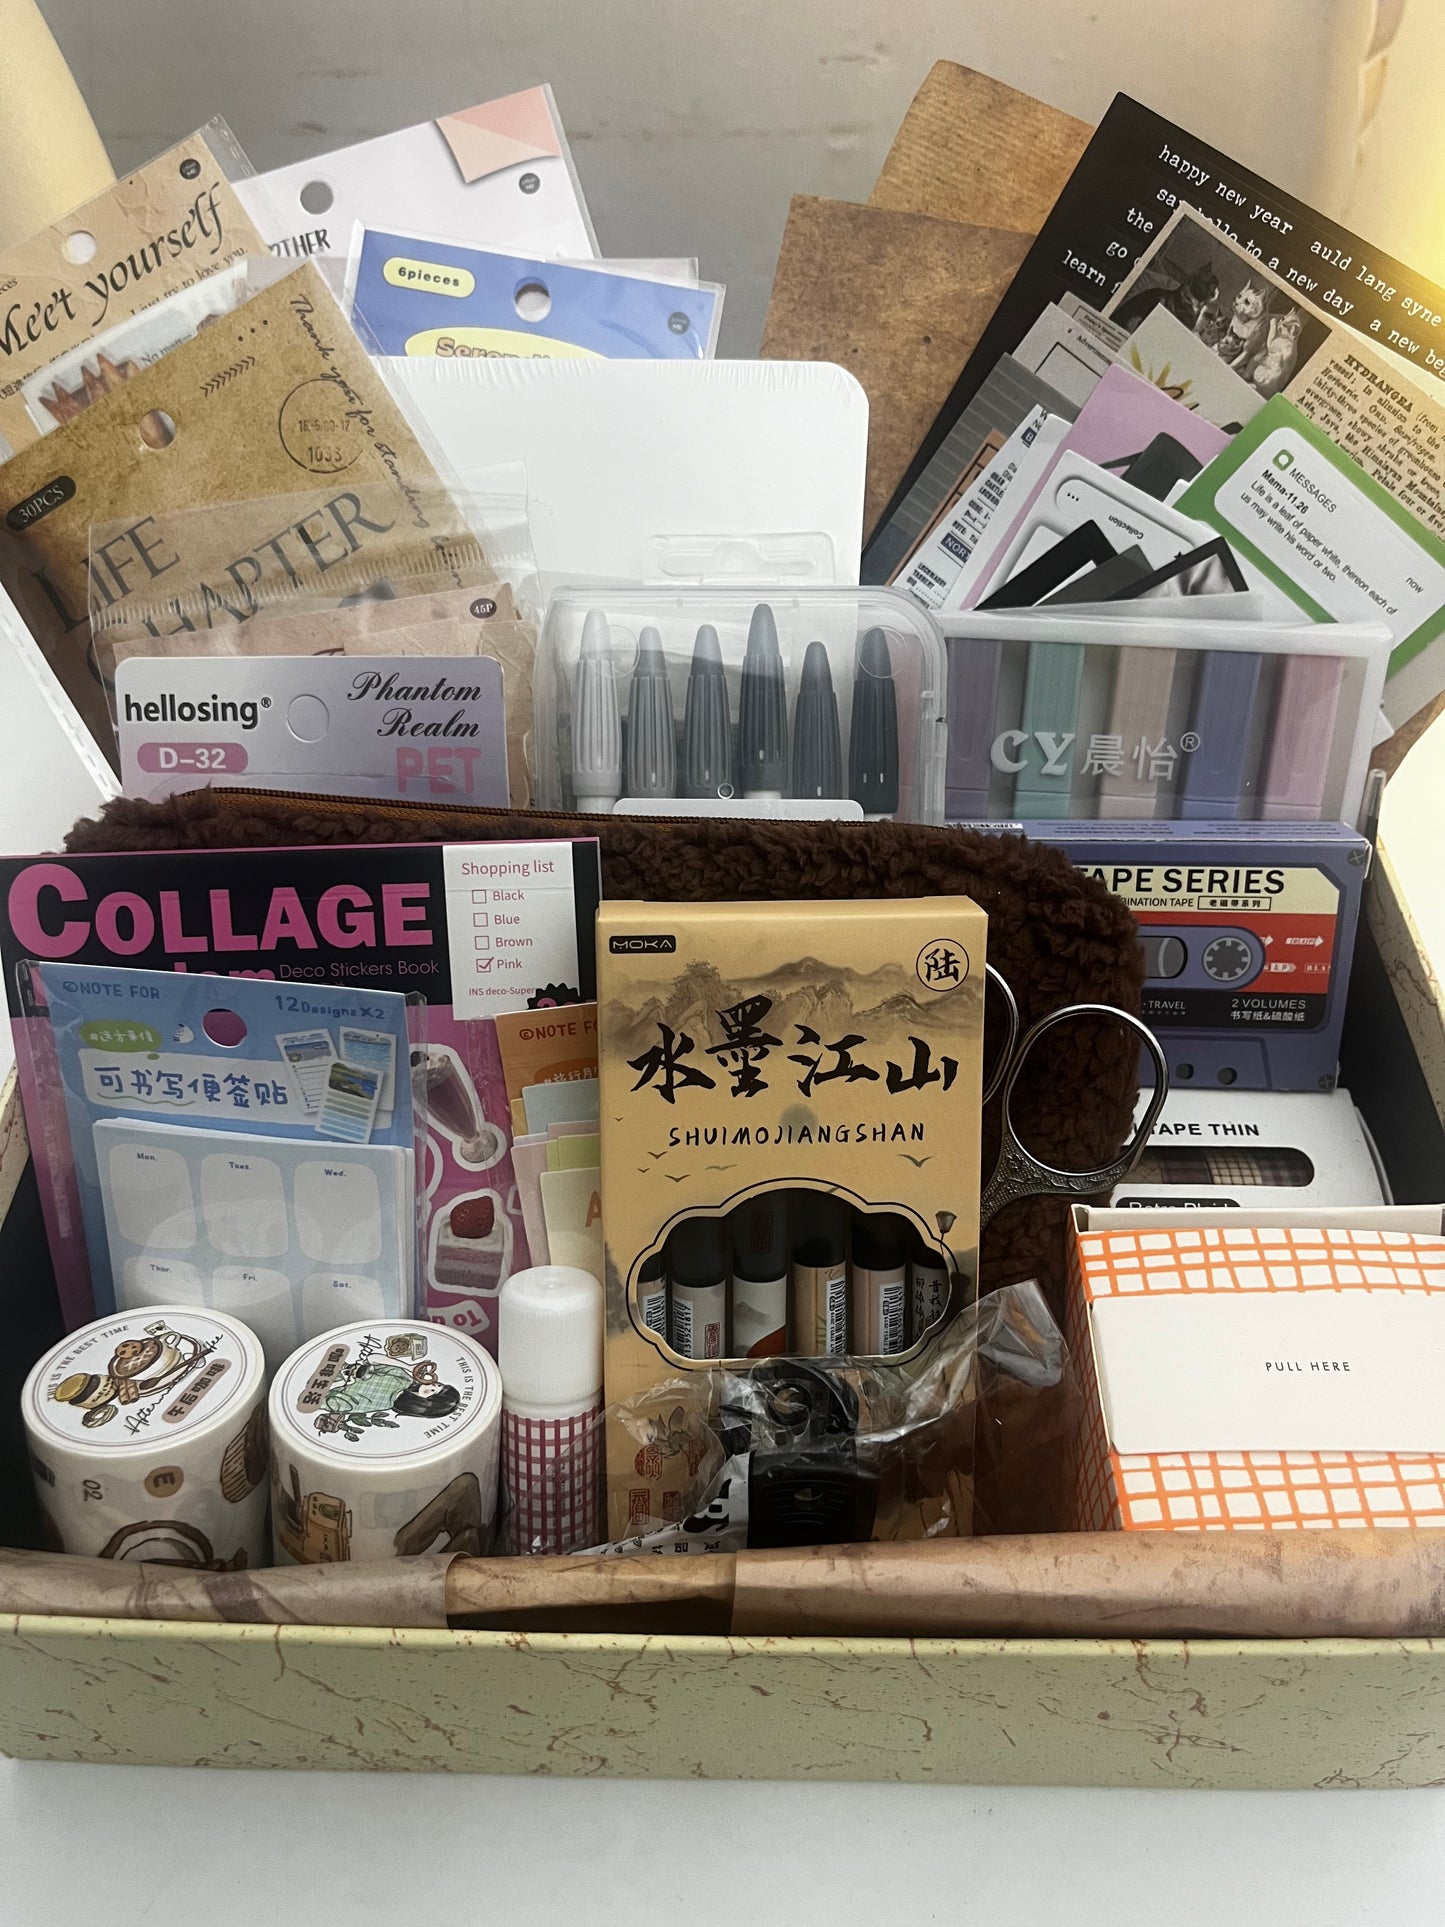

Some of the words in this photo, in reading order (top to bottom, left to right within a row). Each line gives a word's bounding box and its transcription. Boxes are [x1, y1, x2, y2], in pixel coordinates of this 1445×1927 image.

[1126, 207, 1153, 235] the
[1158, 144, 1211, 187] happy
[1214, 181, 1247, 207] new
[1249, 203, 1294, 236] year
[1310, 238, 1348, 271] auld
[1357, 265, 1397, 302] lang
[1400, 296, 1442, 327] syne
[1106, 240, 1128, 262] go
[398, 266, 461, 288] 6pieces
[1062, 249, 1106, 287] learn
[1156, 188, 1184, 213] sa
[1268, 257, 1280, 270] a
[1286, 266, 1318, 293] new
[1323, 285, 1354, 317] day
[1369, 319, 1382, 333] a
[1387, 328, 1420, 354] new
[290, 294, 336, 360] Thank
[345, 409, 376, 438] for
[1344, 354, 1414, 413] HYDRANGEA
[1289, 467, 1338, 514] MESSAGES
[17, 486, 66, 524] 30PCS
[1240, 493, 1251, 504] us
[1250, 501, 1268, 520] may
[1266, 517, 1284, 535] write
[1283, 530, 1296, 545] his
[1295, 544, 1315, 562] word
[1313, 559, 1323, 569] or
[1250, 480, 1265, 498] Life
[1264, 493, 1272, 504] is
[1278, 505, 1295, 522] leaf
[1292, 519, 1303, 529] of
[1299, 527, 1323, 549] paper
[1368, 589, 1387, 608] each
[33, 516, 181, 633] LIFE
[1405, 577, 1424, 594] now
[347, 671, 482, 702] Phantom
[377, 707, 481, 738] Realm
[396, 746, 483, 795] PET
[461, 860, 530, 878] Shopping
[533, 859, 555, 873] list
[1081, 868, 1153, 892] APE
[1162, 868, 1285, 895] SERIES
[493, 890, 525, 901] Black
[1170, 898, 1194, 907] TAPE
[8, 863, 434, 958] COLLAGE
[494, 914, 521, 925] Blue
[495, 937, 533, 948] Brown
[612, 938, 674, 951] MOKA
[280, 963, 326, 978] Deco
[330, 961, 393, 977] Stickers
[398, 959, 440, 975] Book
[497, 958, 523, 969] Pink
[924, 947, 961, 983] 陆
[130, 986, 160, 999] FOR
[469, 987, 484, 996] INS
[1231, 998, 1239, 1009] 2
[1242, 998, 1307, 1010] VOLUMES
[1149, 1000, 1186, 1010] TRAVEL
[626, 994, 959, 1104] 水墨江山
[94, 1065, 289, 1109] 可书写便签贴
[668, 1122, 925, 1148] SHUIMOJIANGSHAN
[1208, 1123, 1260, 1136] THIN
[58, 1353, 75, 1372] THE
[75, 1338, 98, 1356] BEST
[101, 1324, 129, 1338] TIME
[455, 1356, 471, 1375] THIS
[1265, 1362, 1303, 1372] PULL
[1310, 1361, 1351, 1372] HERE
[461, 1386, 475, 1402] THE
[424, 1422, 450, 1439] TIME
